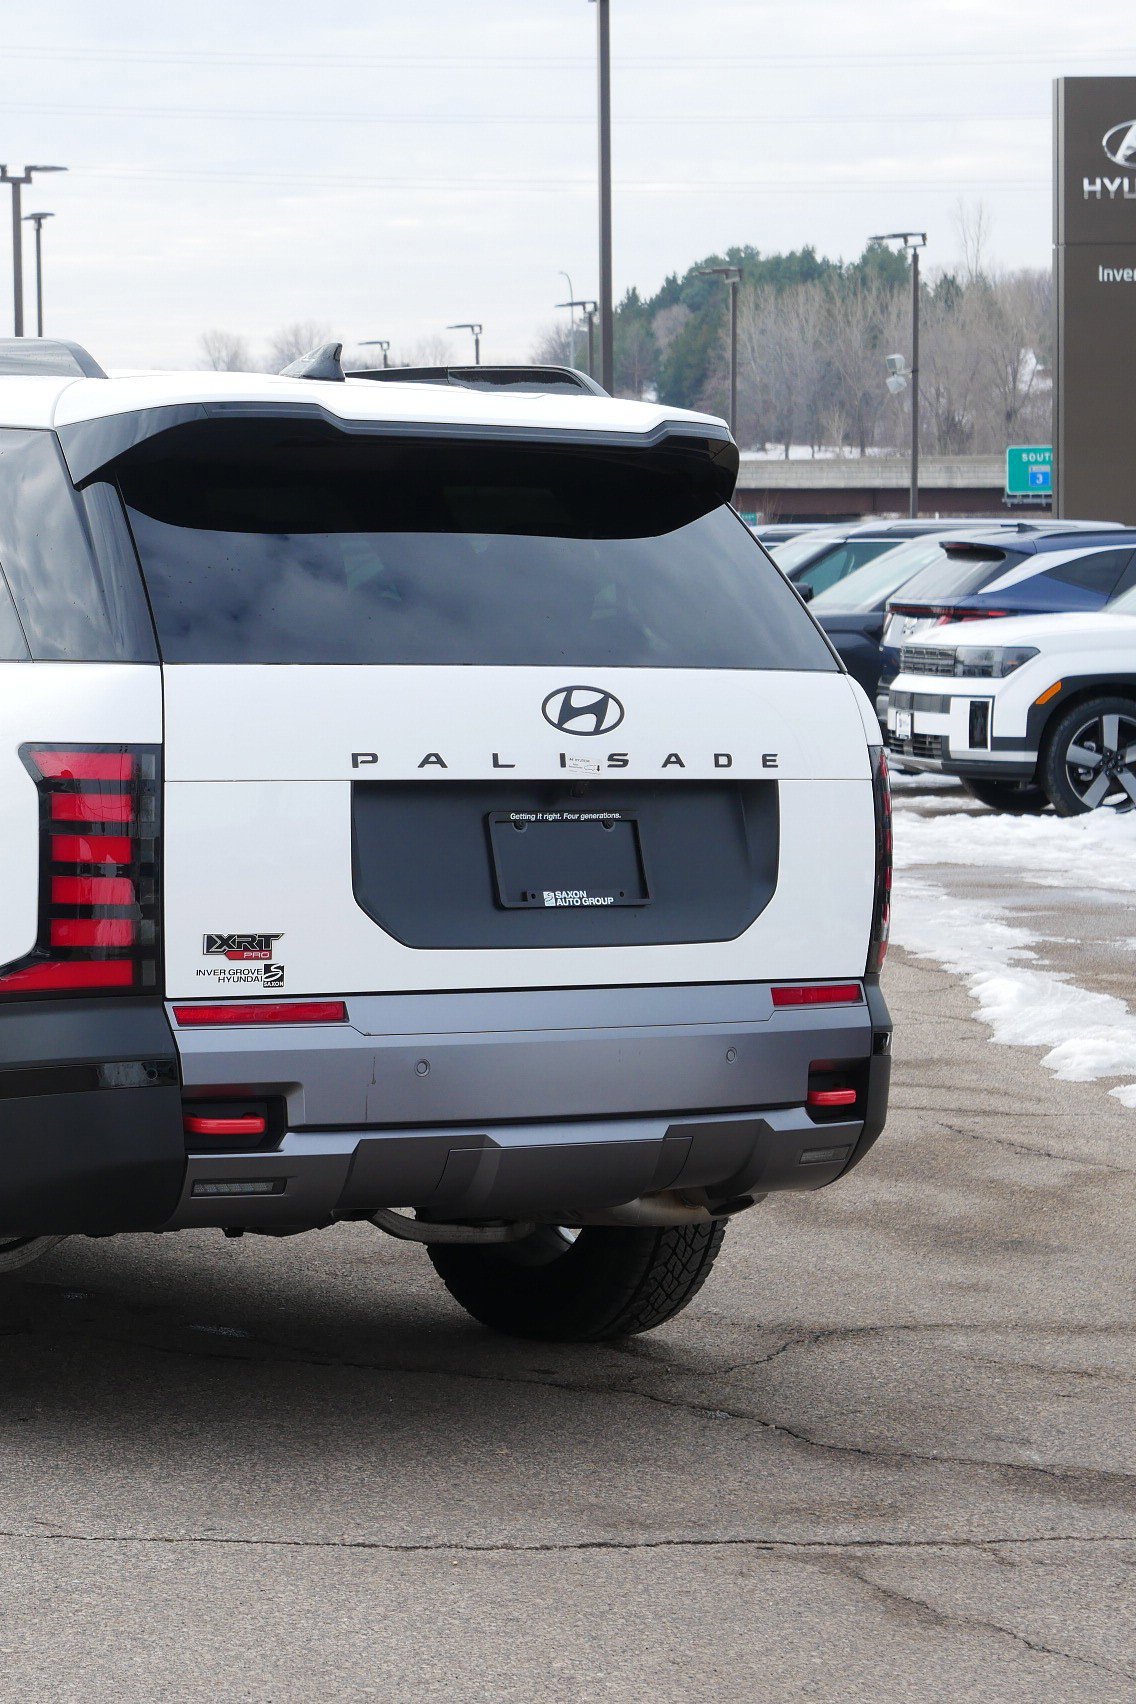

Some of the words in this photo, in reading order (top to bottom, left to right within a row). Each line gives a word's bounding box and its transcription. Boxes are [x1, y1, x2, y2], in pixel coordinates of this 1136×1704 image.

[1036, 473, 1044, 484] 3
[352, 753, 779, 768] PALISADE
[510, 812, 536, 821] Getting
[543, 812, 562, 821] right.
[563, 812, 579, 820] Four
[580, 812, 622, 820] generations.
[556, 898, 581, 906] AUTO
[581, 897, 614, 905] GROUP
[204, 933, 285, 951] XRT
[243, 951, 270, 959] PRO
